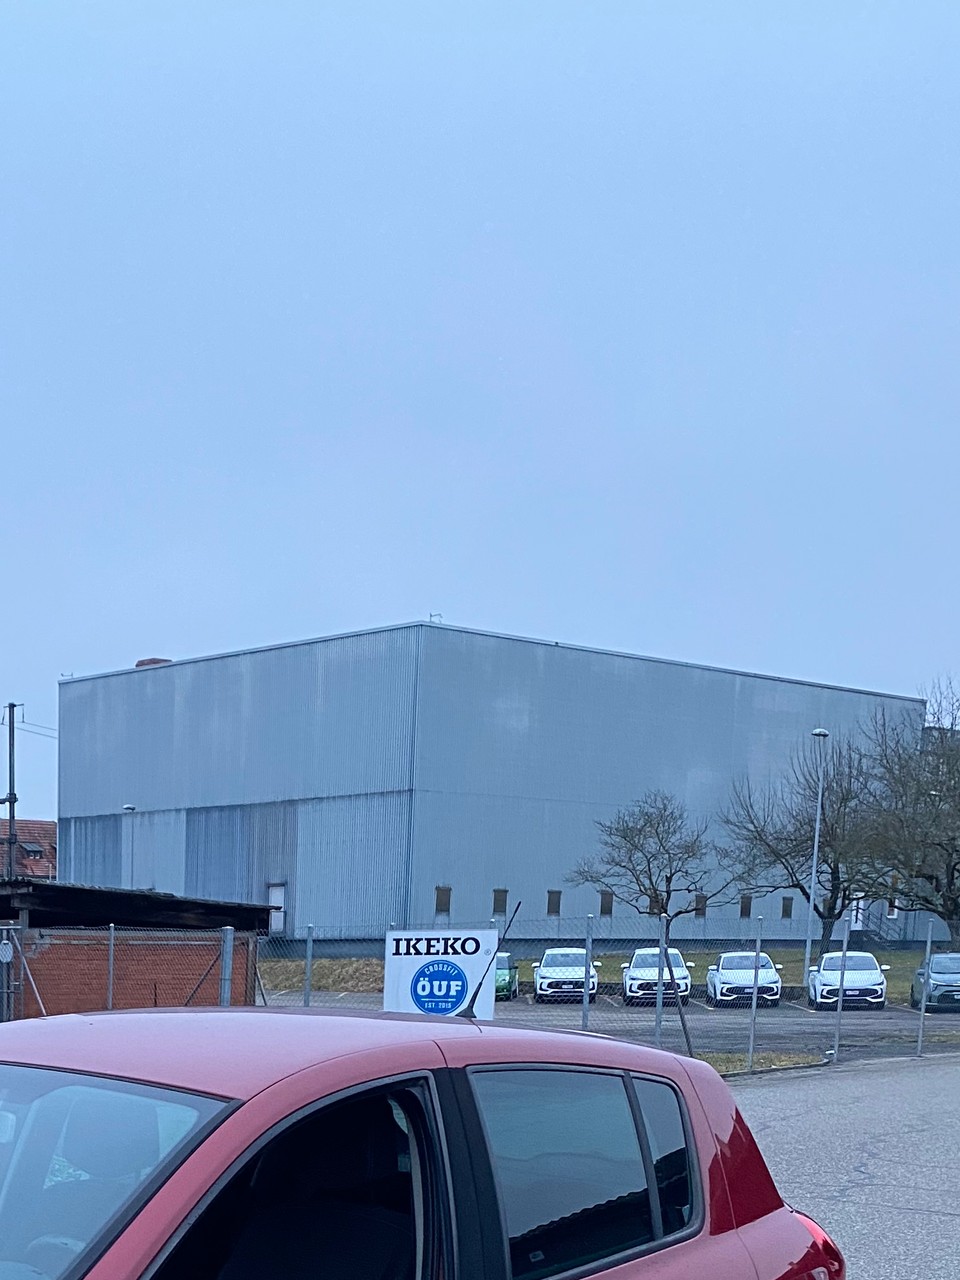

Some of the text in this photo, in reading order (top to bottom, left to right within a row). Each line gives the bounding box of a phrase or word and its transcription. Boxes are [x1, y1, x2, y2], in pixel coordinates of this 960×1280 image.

[392, 937, 480, 955] IKEKO
[424, 963, 458, 976] CROSSFIT
[417, 977, 462, 996] ÖUF
